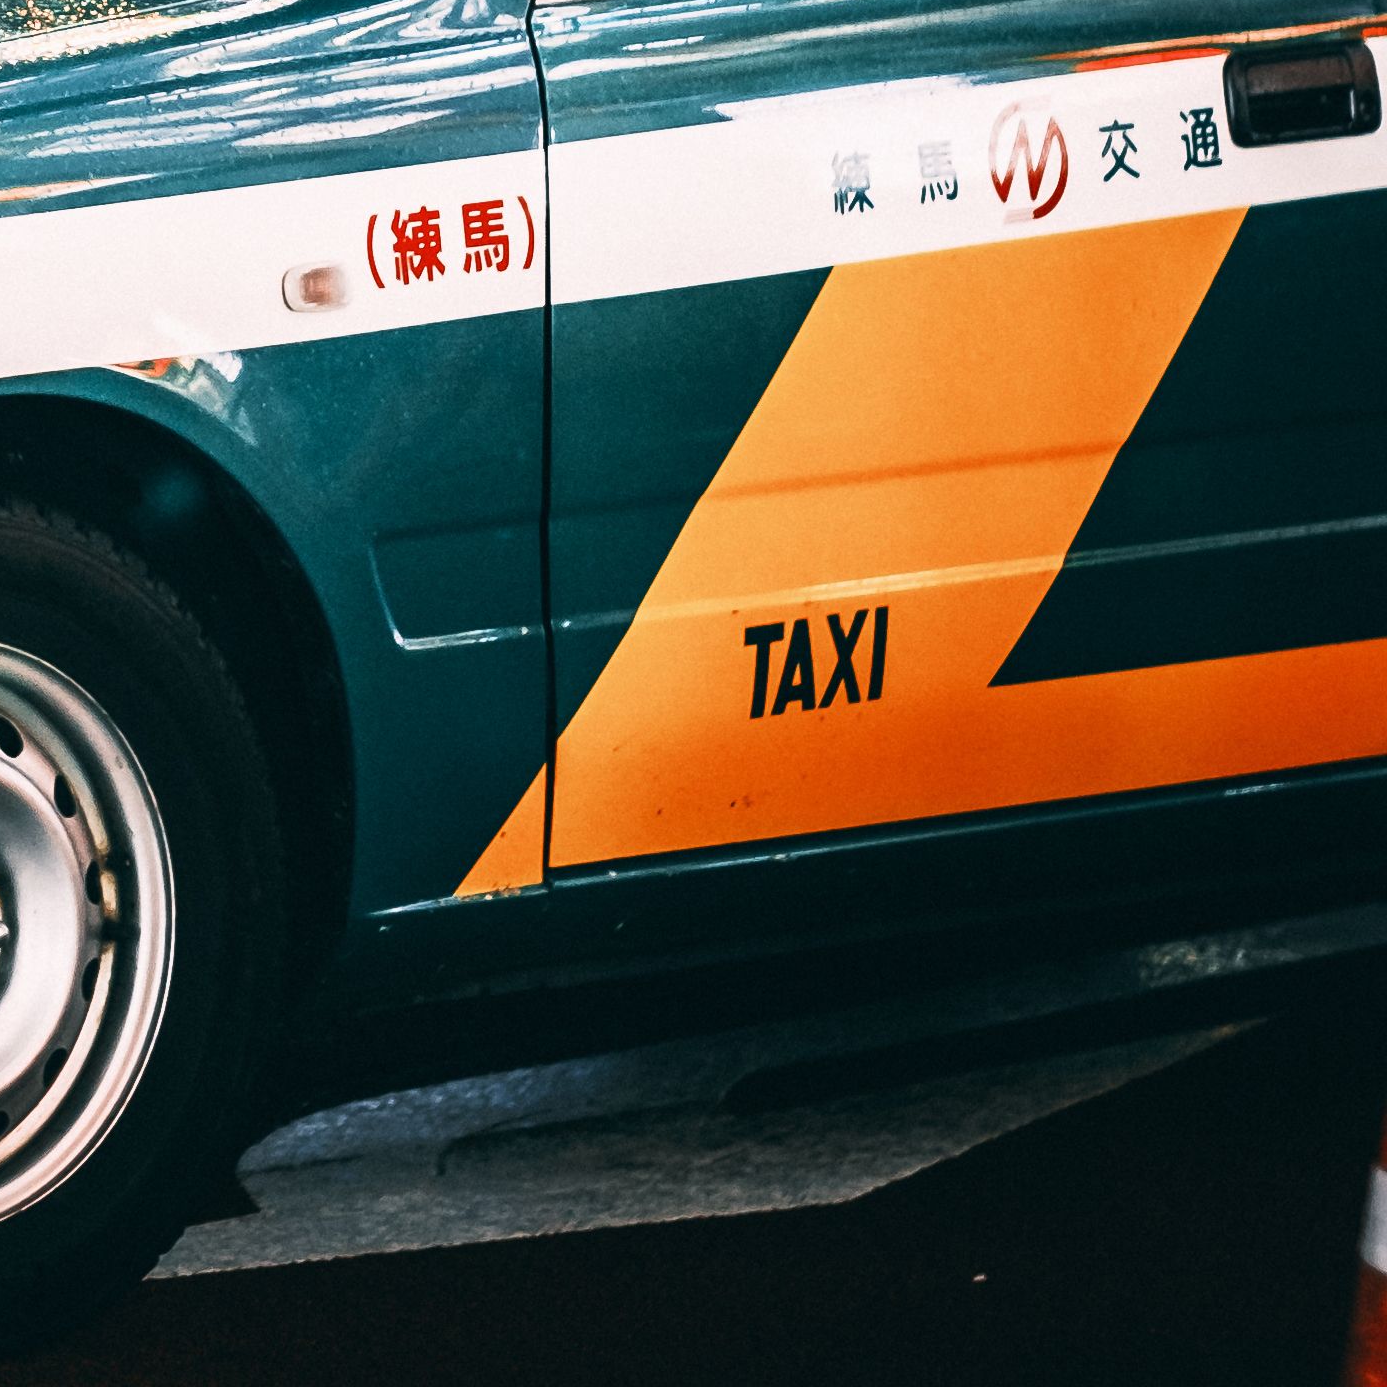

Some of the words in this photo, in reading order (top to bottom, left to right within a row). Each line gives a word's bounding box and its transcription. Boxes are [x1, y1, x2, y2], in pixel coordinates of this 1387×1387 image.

[830, 140, 959, 215] 練馬
[1098, 106, 1224, 183] 交通
[366, 196, 535, 289] (練馬)
[743, 605, 890, 720] TAXI
